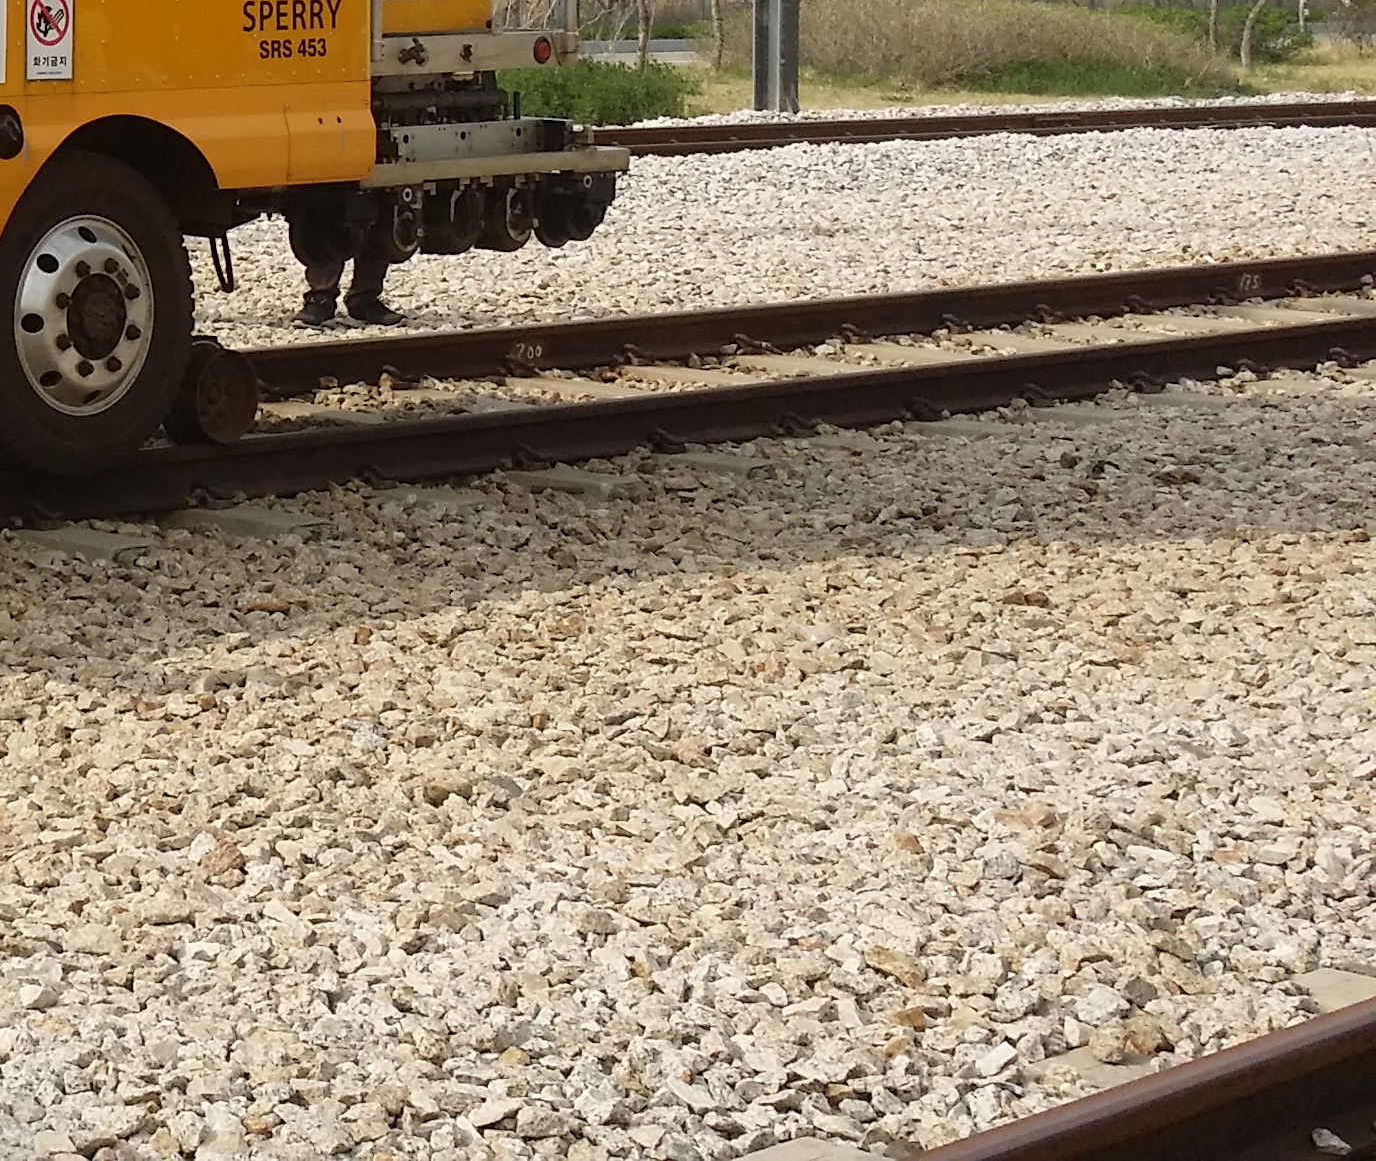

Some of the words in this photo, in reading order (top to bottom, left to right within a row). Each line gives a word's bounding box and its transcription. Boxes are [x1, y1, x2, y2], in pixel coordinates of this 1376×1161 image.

[259, 39, 294, 59] SRS
[297, 38, 327, 57] 453
[33, 55, 68, 67] 화기금지
